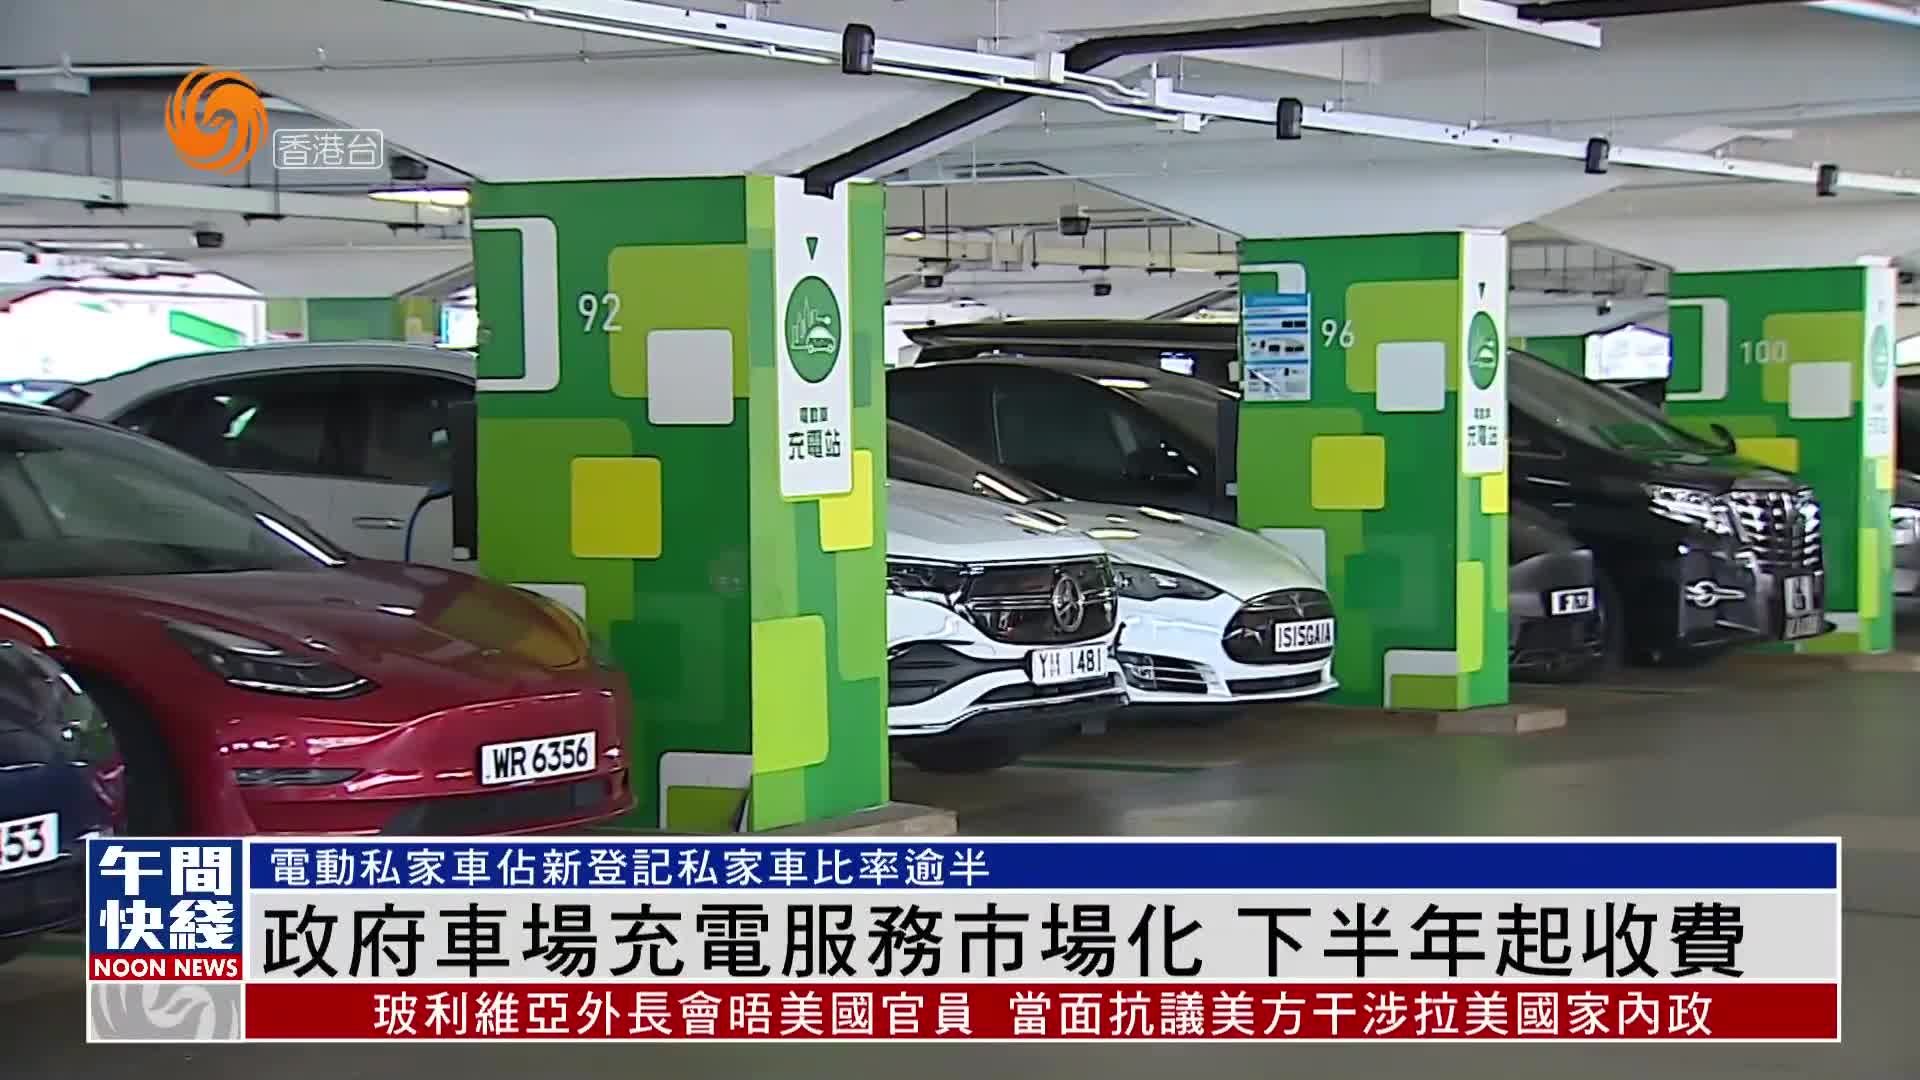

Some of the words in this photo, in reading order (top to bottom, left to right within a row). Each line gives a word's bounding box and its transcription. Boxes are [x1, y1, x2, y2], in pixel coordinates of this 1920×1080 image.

[579, 293, 623, 332] 92
[1322, 319, 1355, 348] 96
[788, 428, 840, 460] 充電站
[493, 746, 527, 778] WR
[532, 737, 588, 773] 6356
[0, 820, 45, 863] 53
